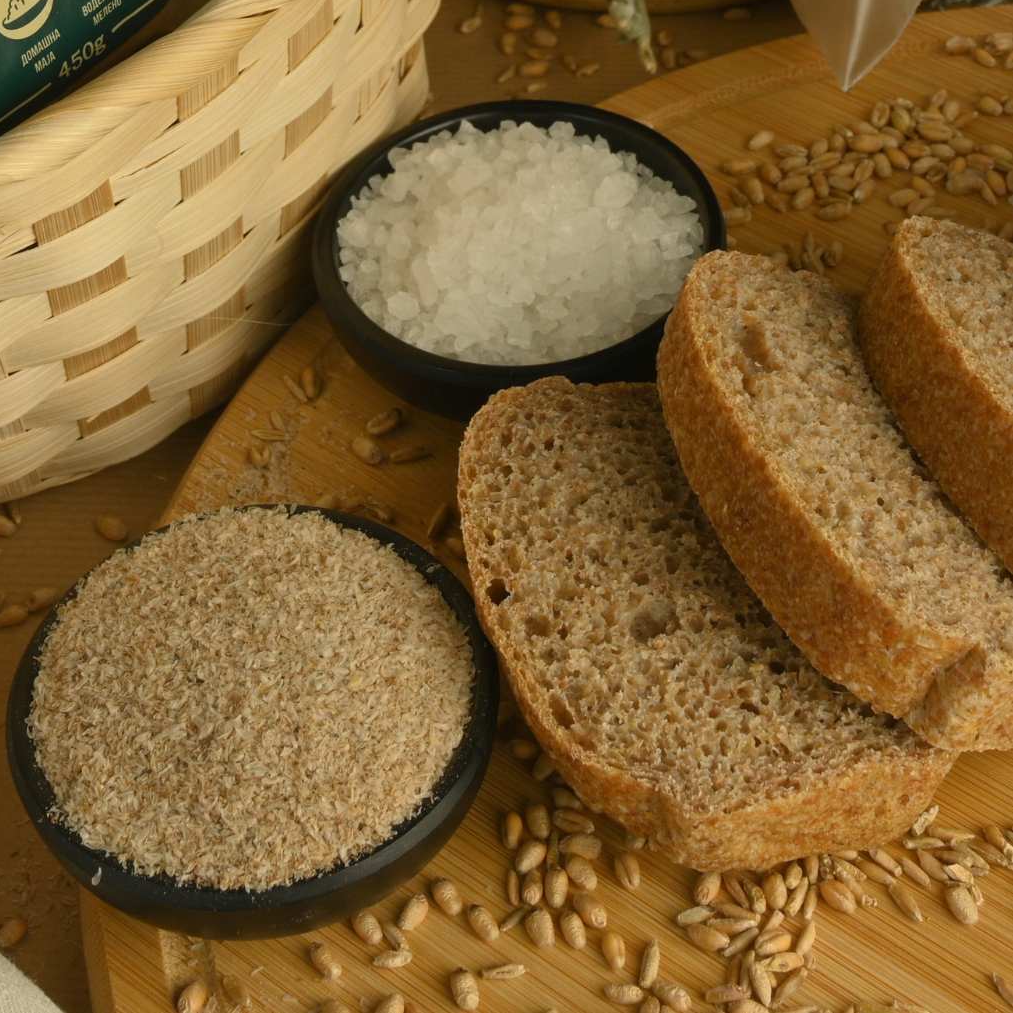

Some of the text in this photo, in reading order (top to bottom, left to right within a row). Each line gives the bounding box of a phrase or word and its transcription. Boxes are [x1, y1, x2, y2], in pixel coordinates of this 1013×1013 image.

[21, 28, 62, 68] ДОМАШНА
[34, 51, 57, 74] МАЈА
[58, 34, 108, 79] 450g
